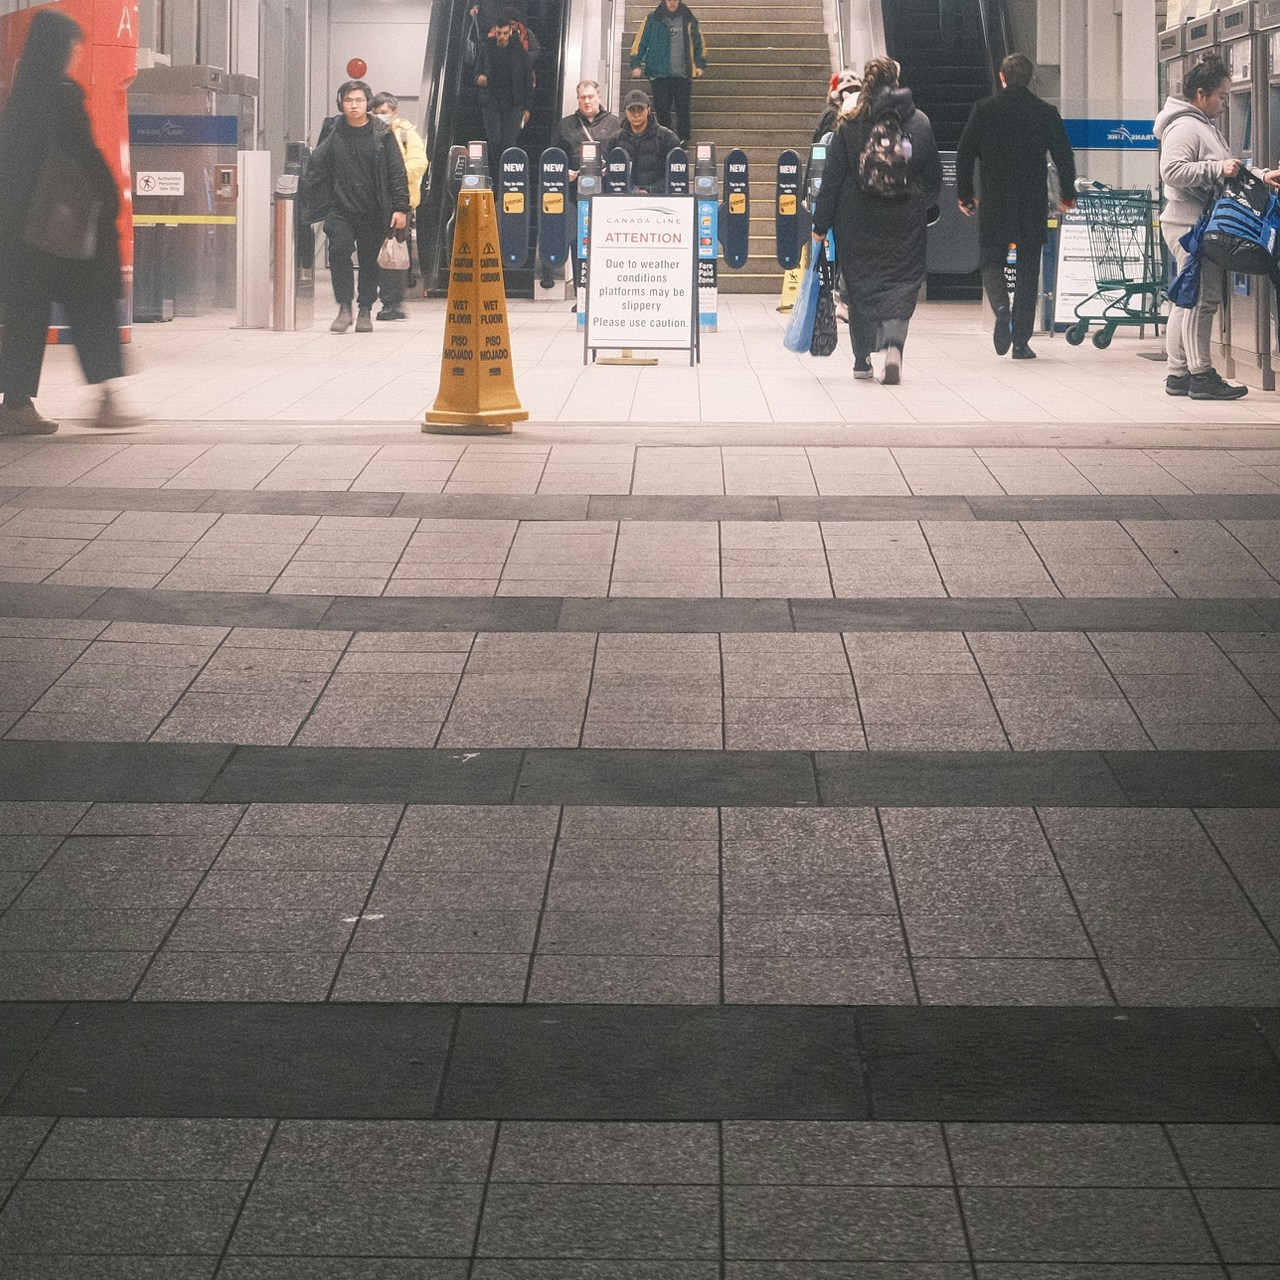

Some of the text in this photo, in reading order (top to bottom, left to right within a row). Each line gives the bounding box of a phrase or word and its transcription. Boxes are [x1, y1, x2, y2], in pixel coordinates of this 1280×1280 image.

[503, 163, 525, 173] NEW
[543, 163, 565, 173] NEW
[609, 163, 626, 172] NEW
[670, 163, 687, 173] NEW
[729, 164, 746, 173] NEW
[780, 165, 797, 174] NEW
[605, 232, 682, 244] ATTENTION
[605, 258, 680, 270] Due to weather
[617, 272, 668, 283] conditions
[599, 286, 685, 298] platforms may be
[453, 300, 468, 310] WET
[483, 300, 498, 310] WET
[621, 300, 662, 312] slippery
[448, 313, 472, 324] FLOOR
[481, 313, 503, 324] FLOOR
[593, 317, 689, 328] Please use caution.
[451, 335, 468, 346] PISO
[485, 335, 501, 347] PISO
[445, 349, 473, 360] MOJADO
[480, 348, 509, 361] MOJADO
